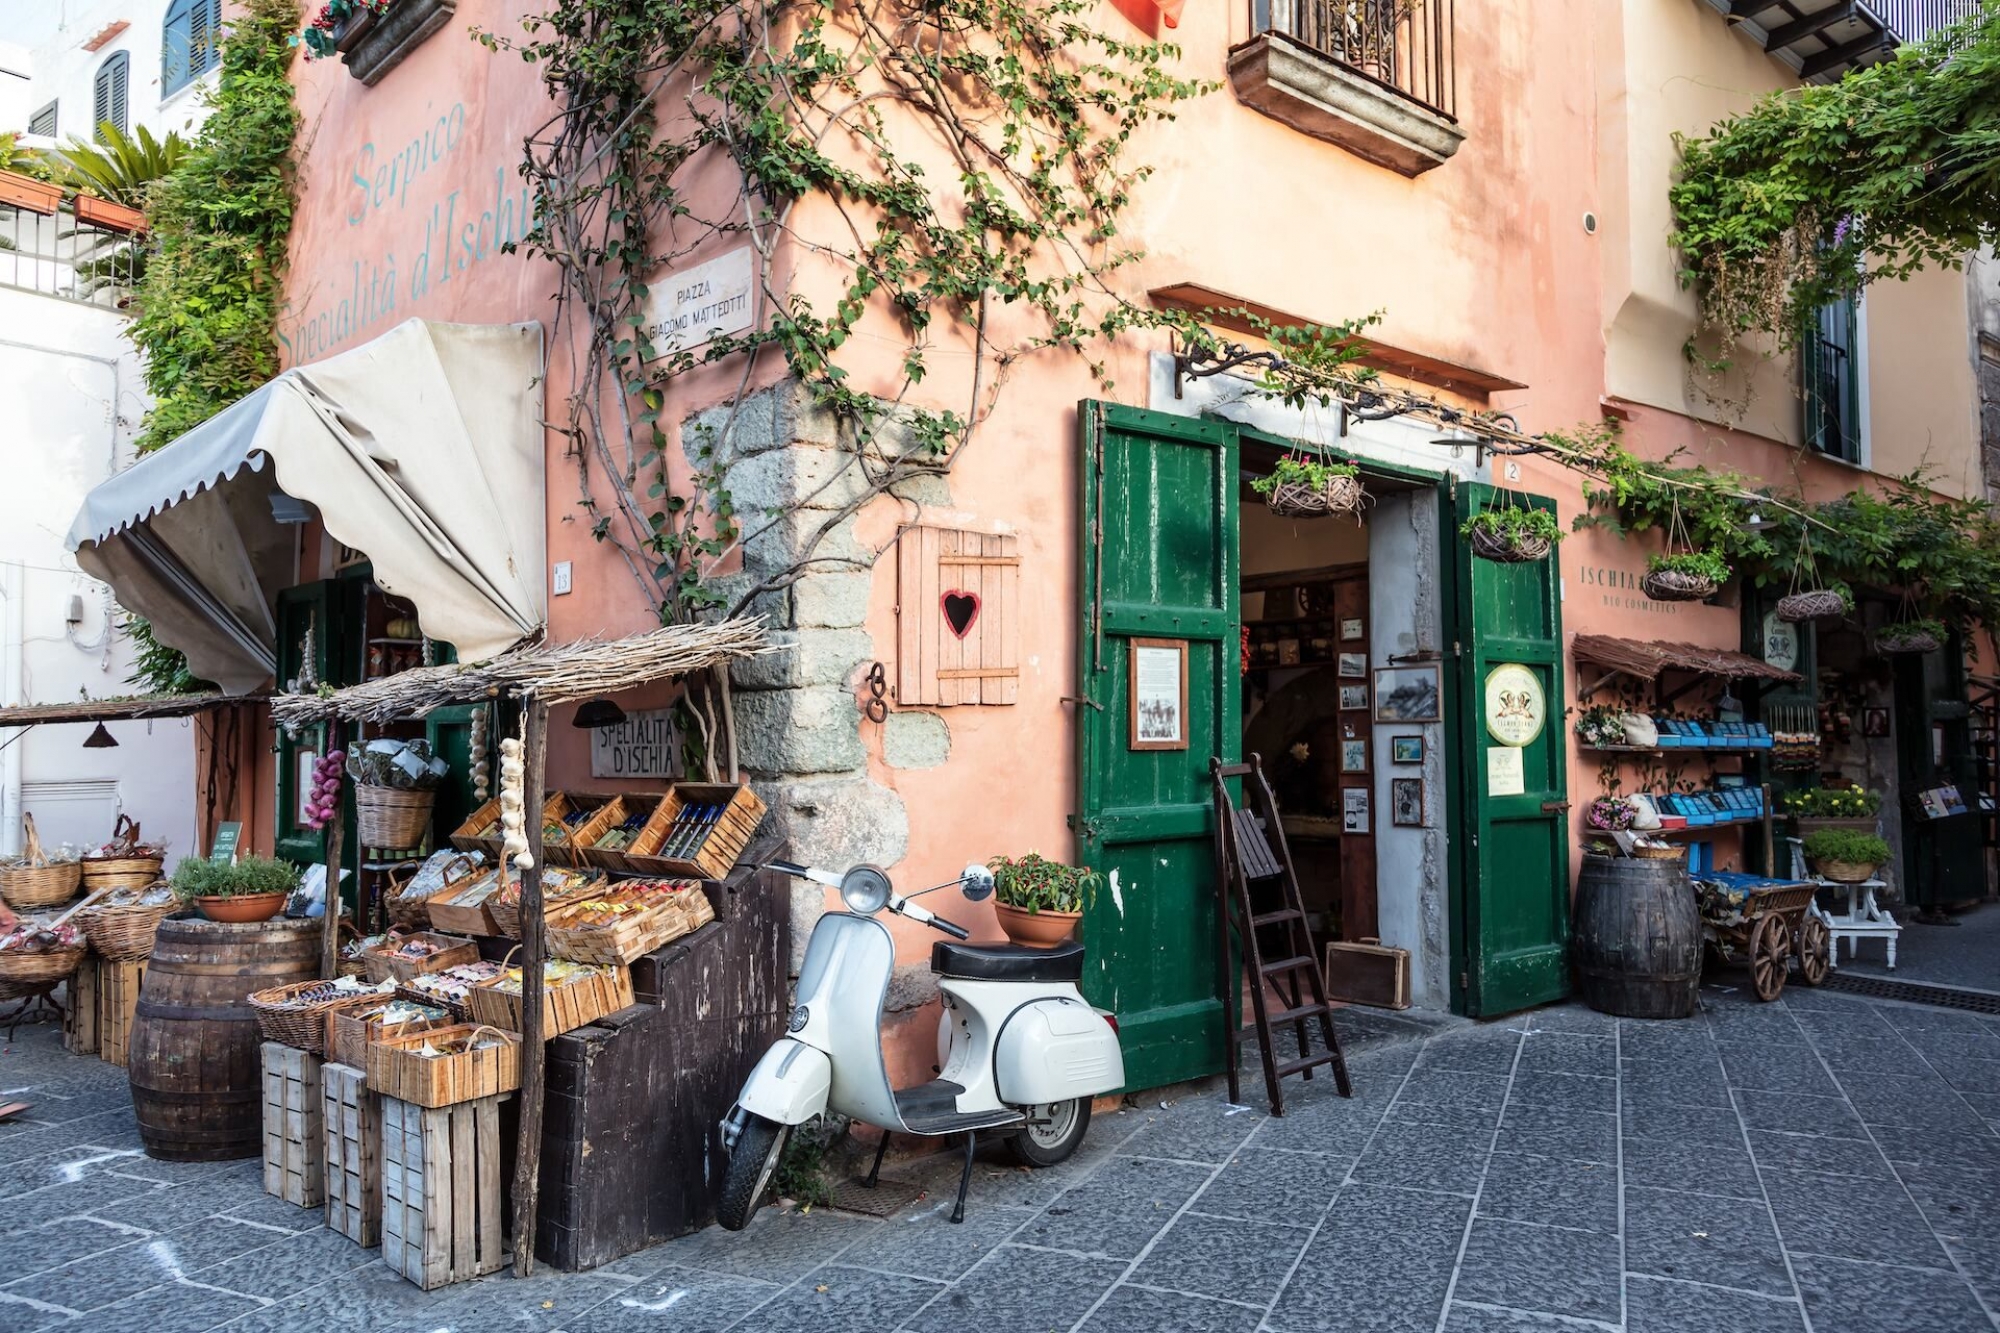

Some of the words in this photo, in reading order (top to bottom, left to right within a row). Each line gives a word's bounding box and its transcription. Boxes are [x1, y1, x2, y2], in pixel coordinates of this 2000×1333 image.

[348, 100, 465, 225] Serpico
[677, 280, 711, 304] PIAZZA
[274, 253, 397, 370] Specialità
[649, 314, 688, 340] GIACOMO
[693, 294, 746, 325] MATTEOTTI
[1510, 463, 1517, 479] 2
[557, 573, 568, 590] 13
[1581, 566, 1635, 590] ISCHIA
[1603, 595, 1620, 607] BIO
[1625, 598, 1676, 614] COSMETICS
[614, 746, 674, 773] D'ISCHIA
